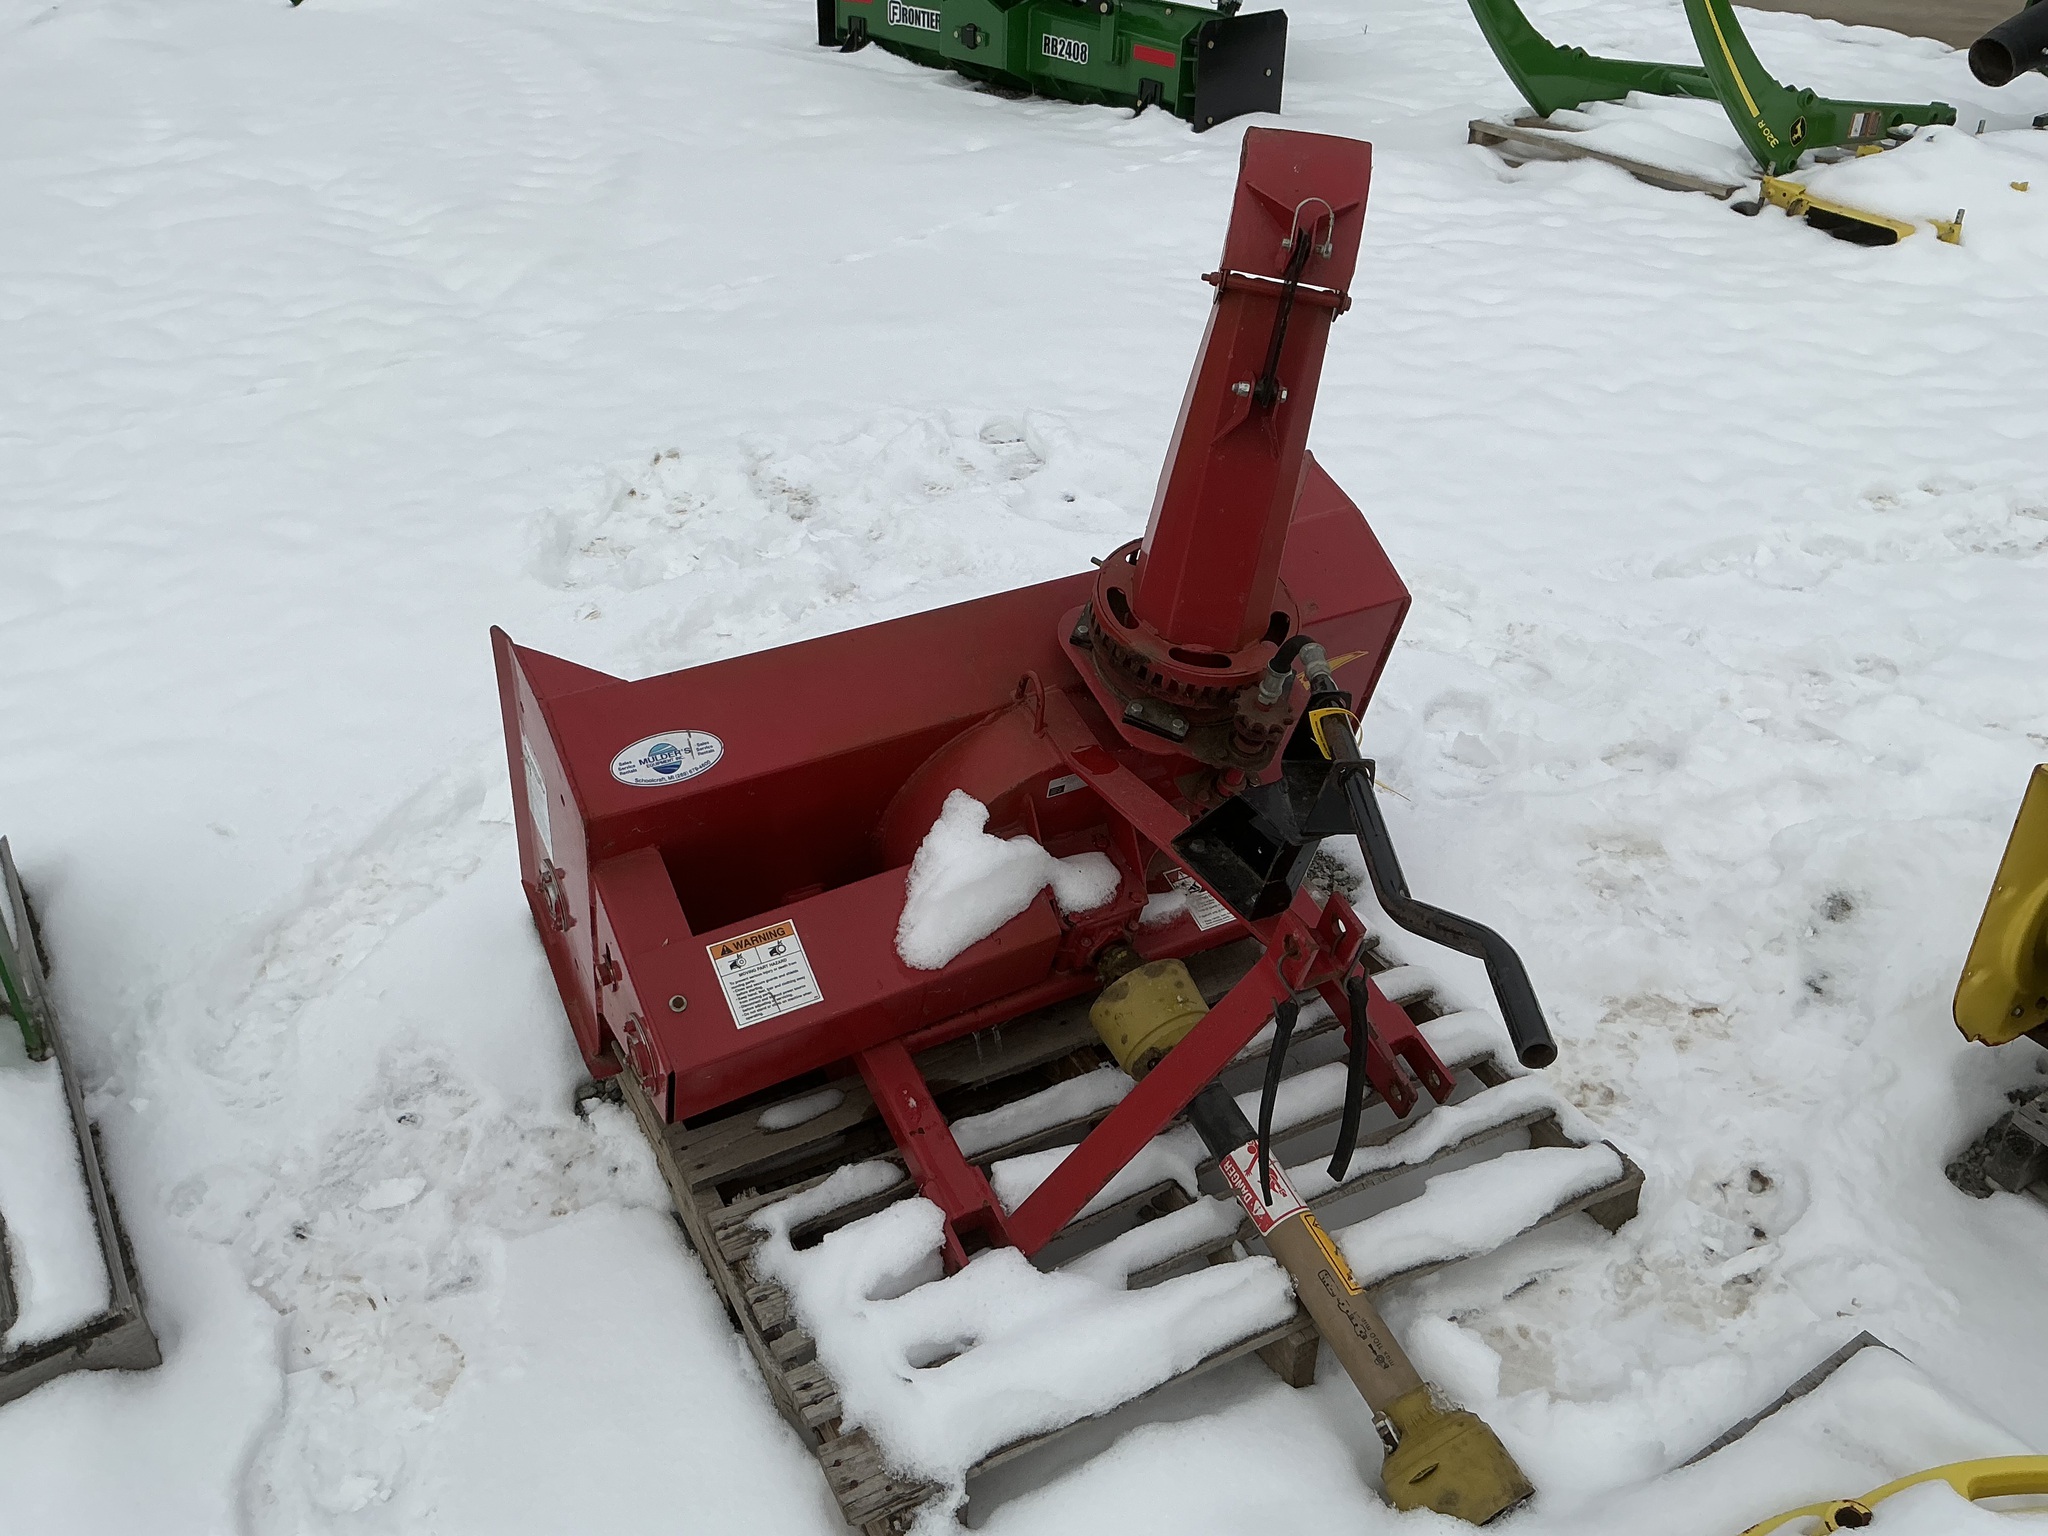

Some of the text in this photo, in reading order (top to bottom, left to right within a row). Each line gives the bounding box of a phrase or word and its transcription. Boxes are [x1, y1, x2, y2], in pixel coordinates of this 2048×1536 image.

[889, 2, 940, 31] FRONTIER
[1043, 35, 1088, 64] RB2408
[1757, 119, 1779, 148] 320 R
[638, 747, 692, 766] MULDER'S
[732, 927, 786, 950] WARNING
[1222, 1159, 1253, 1204] DANGER
